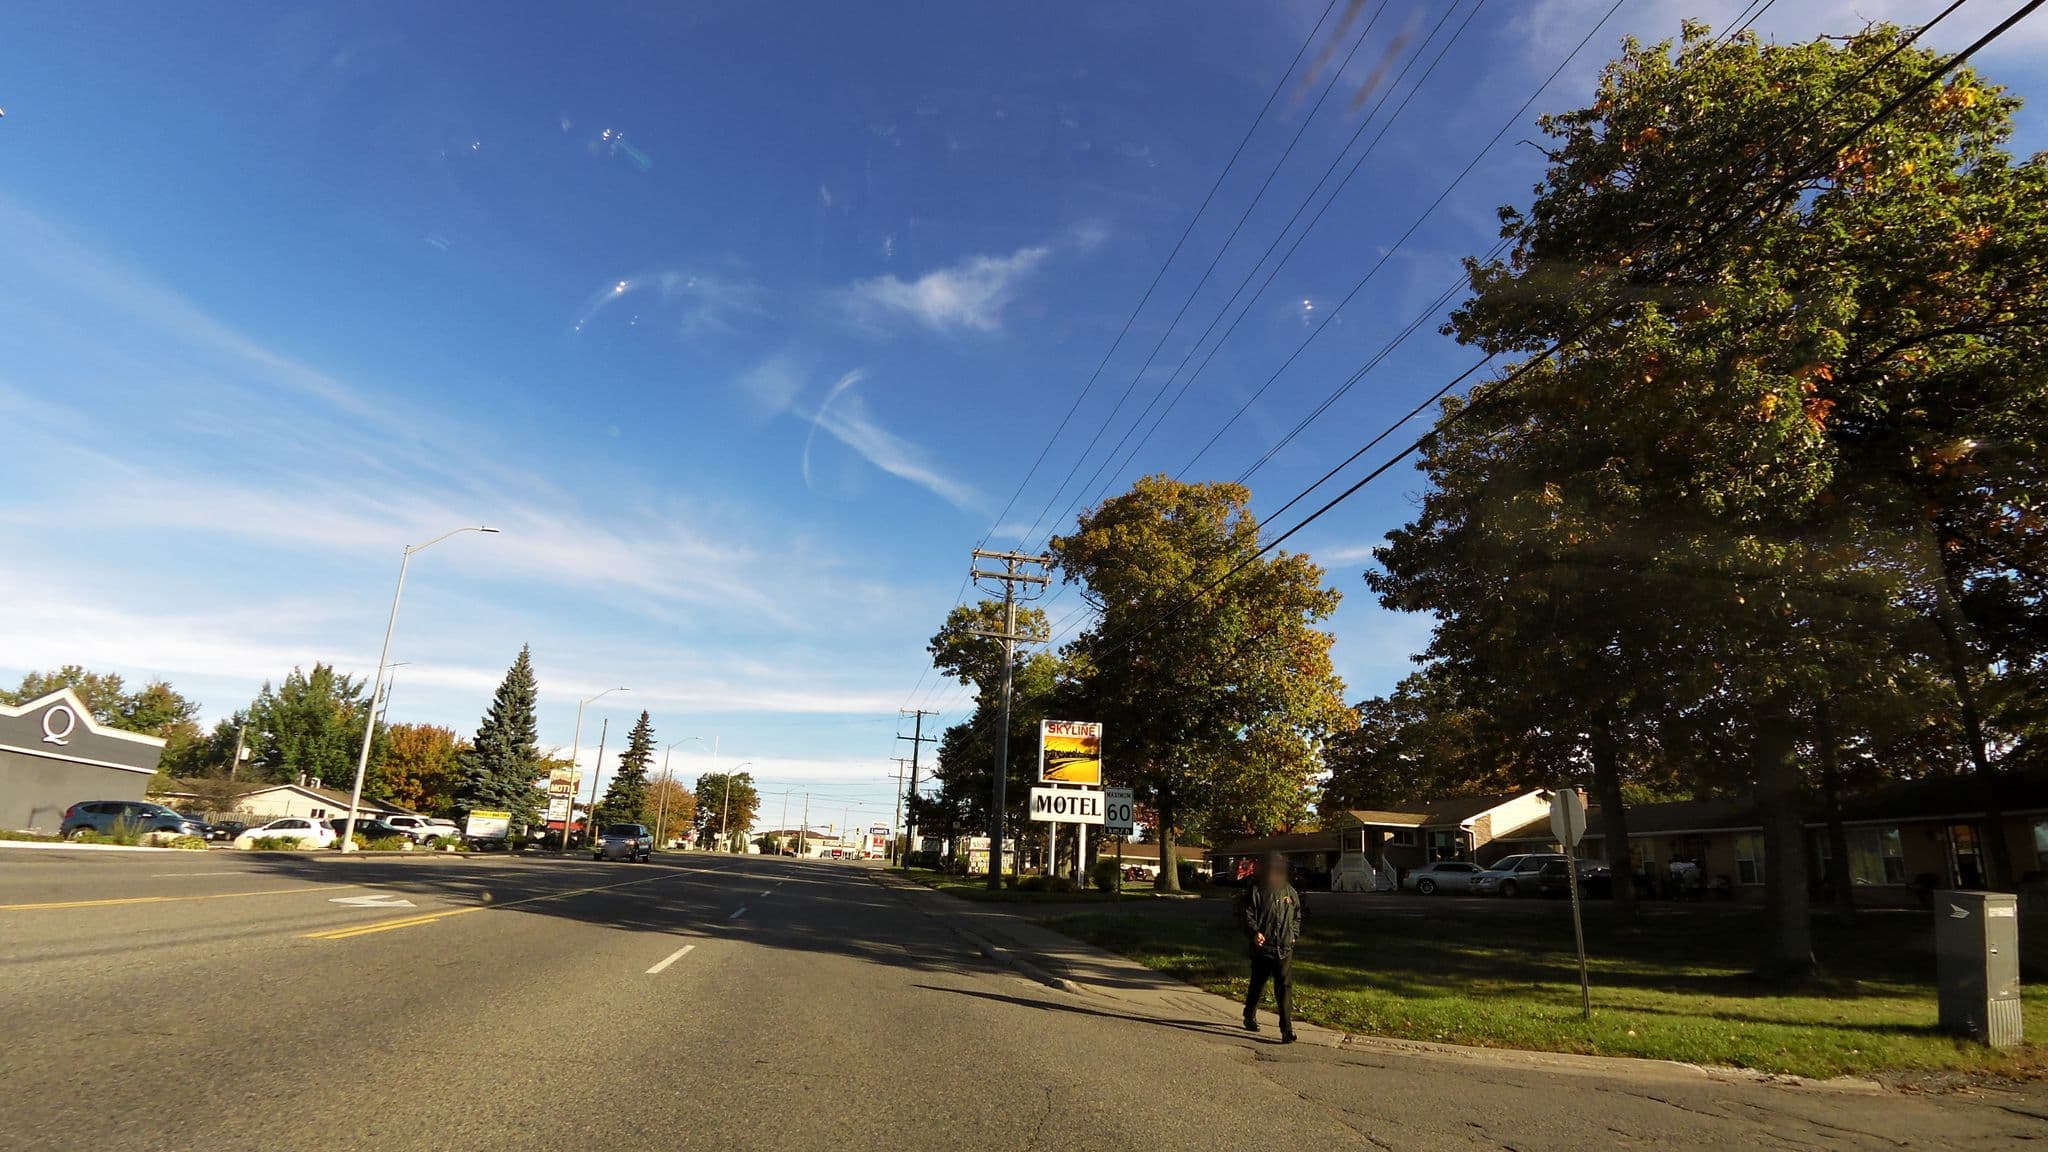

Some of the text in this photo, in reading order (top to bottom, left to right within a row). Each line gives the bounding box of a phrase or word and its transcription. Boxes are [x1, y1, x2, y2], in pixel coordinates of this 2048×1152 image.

[43, 705, 75, 745] Q
[1048, 724, 1095, 736] SKYLINE
[551, 784, 577, 793] MOTL
[1037, 795, 1101, 816] MOTEL
[1107, 804, 1131, 821] 60
